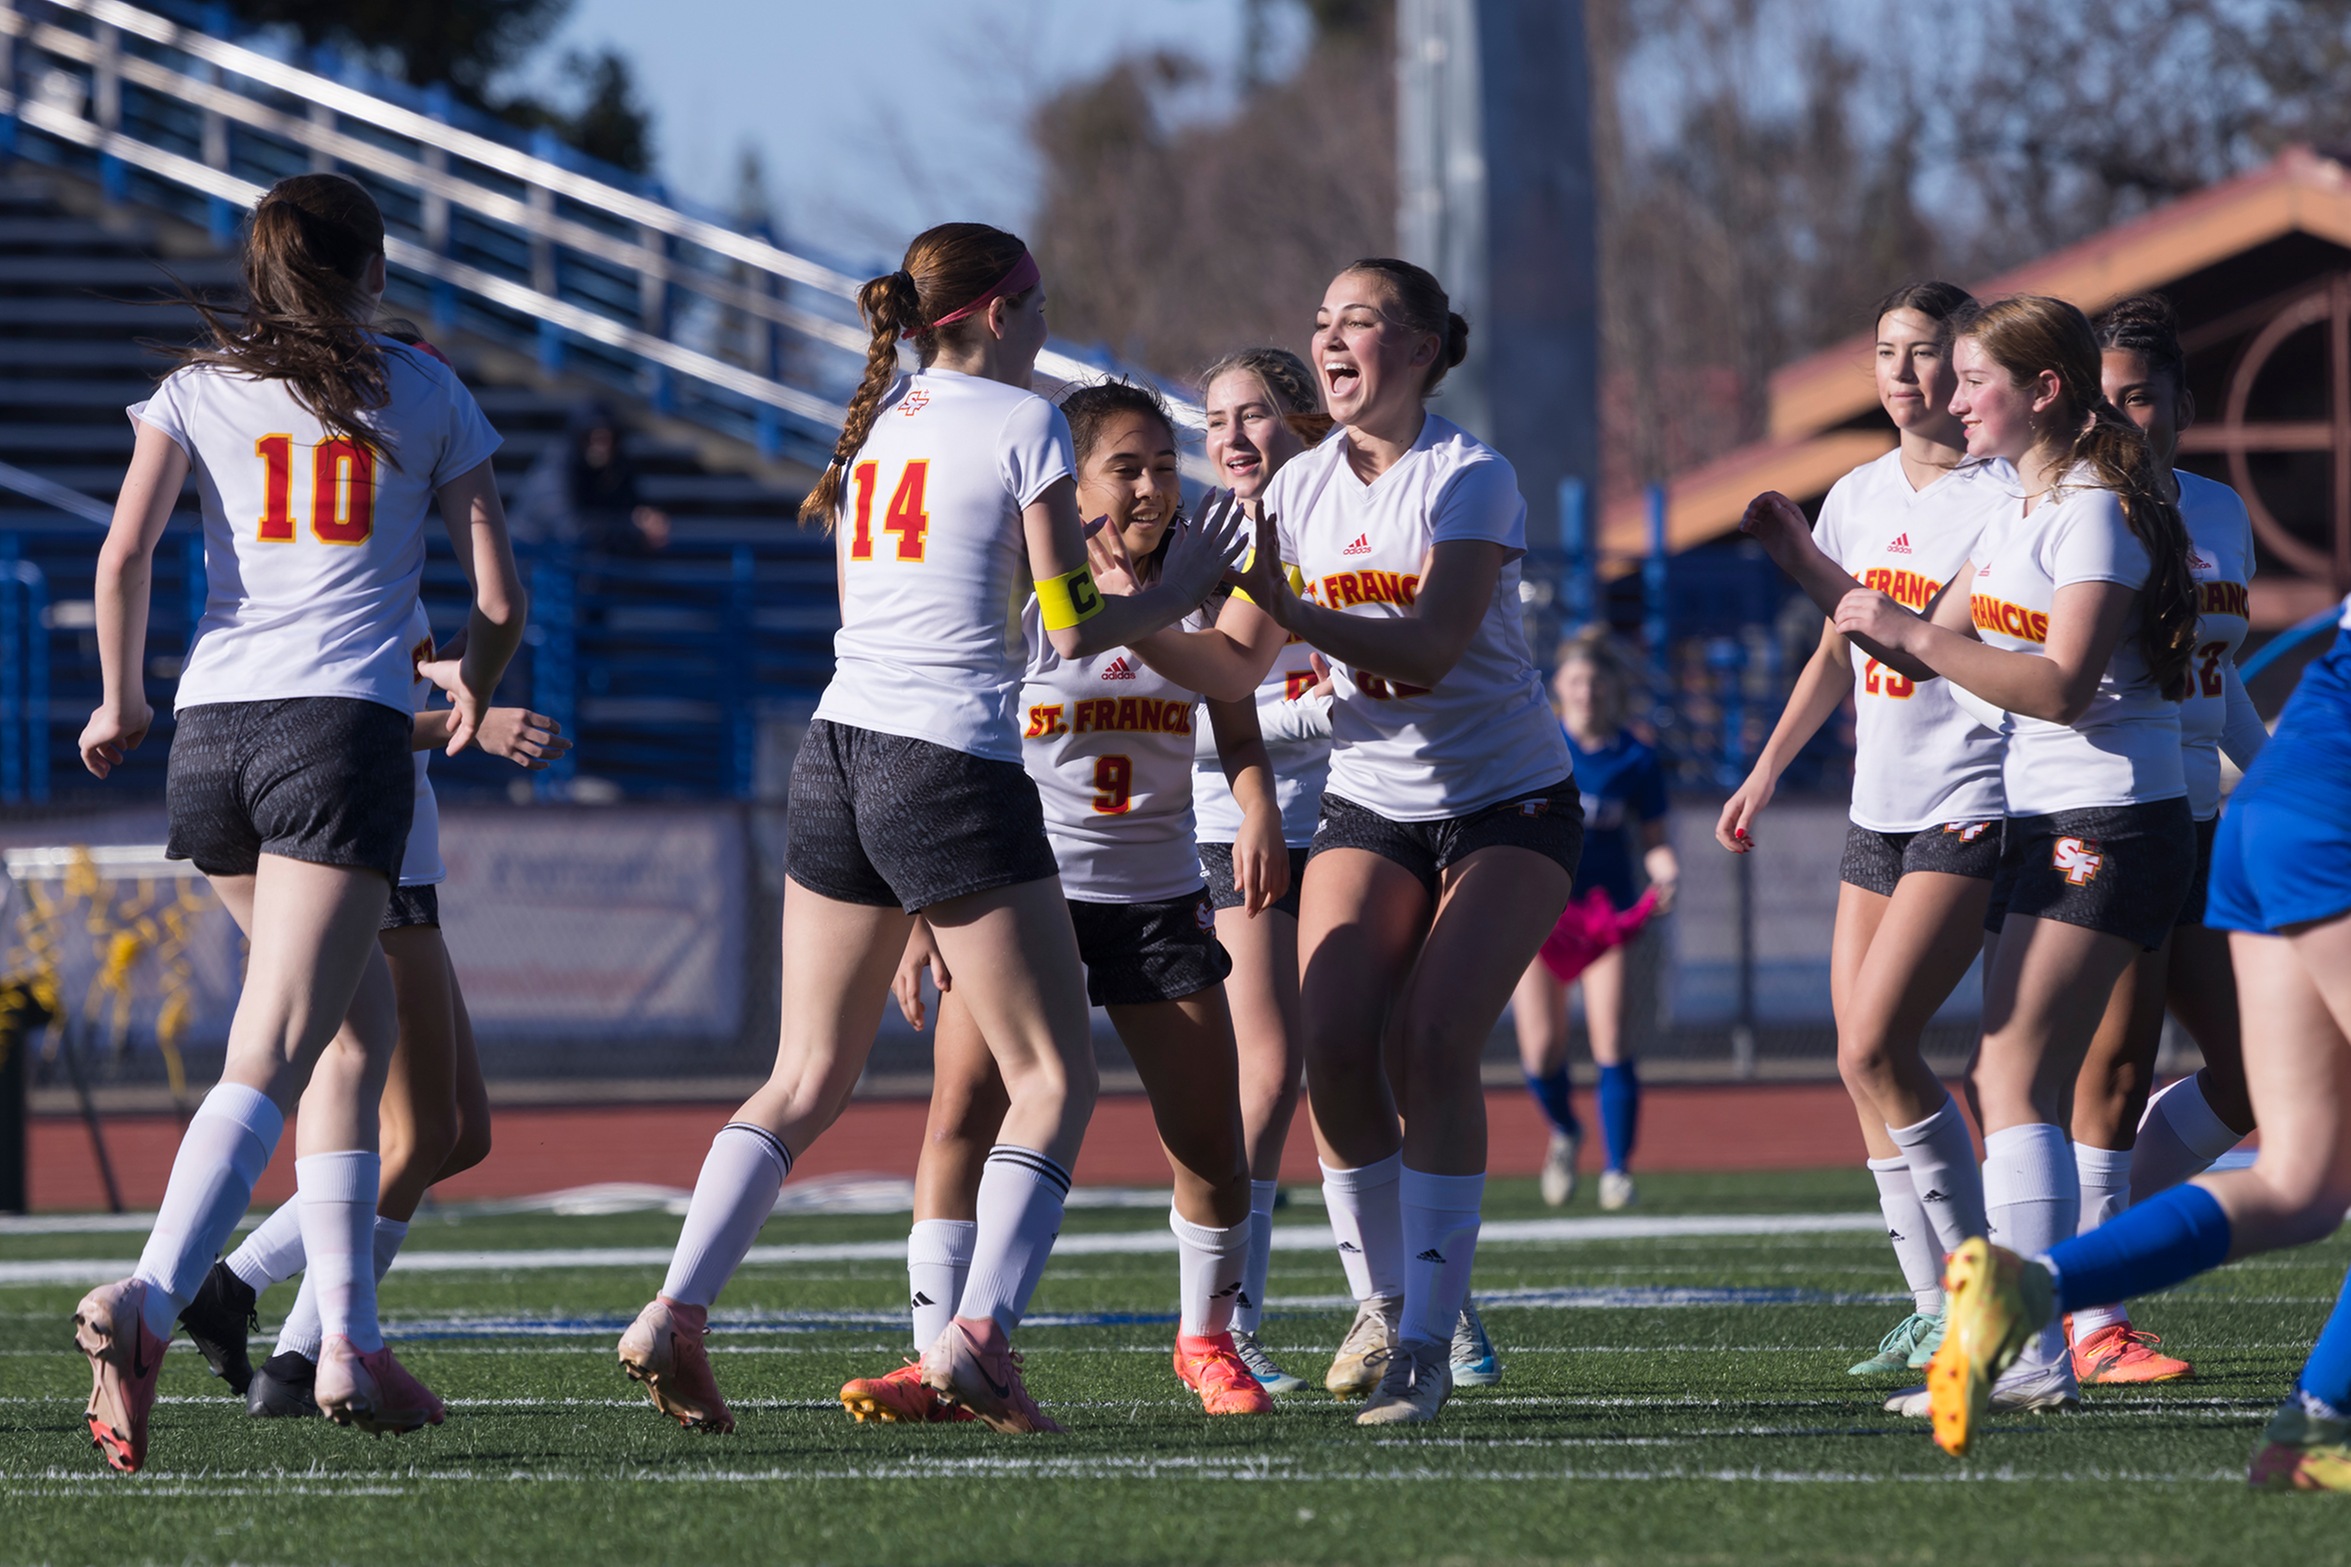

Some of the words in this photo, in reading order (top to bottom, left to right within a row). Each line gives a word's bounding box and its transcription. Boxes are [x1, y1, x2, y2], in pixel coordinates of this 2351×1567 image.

[255, 432, 377, 547] 10
[850, 459, 931, 563] 14
[1343, 546, 1372, 555] adidas
[1887, 545, 1912, 554] adidas
[1067, 571, 1097, 614] C
[1321, 569, 1420, 611] FRANC
[1970, 593, 2050, 644] RANCIS
[1101, 670, 1136, 680] adidas
[1024, 702, 1070, 739] ST.
[1092, 754, 1133, 815] 9
[2050, 836, 2104, 887] SF
